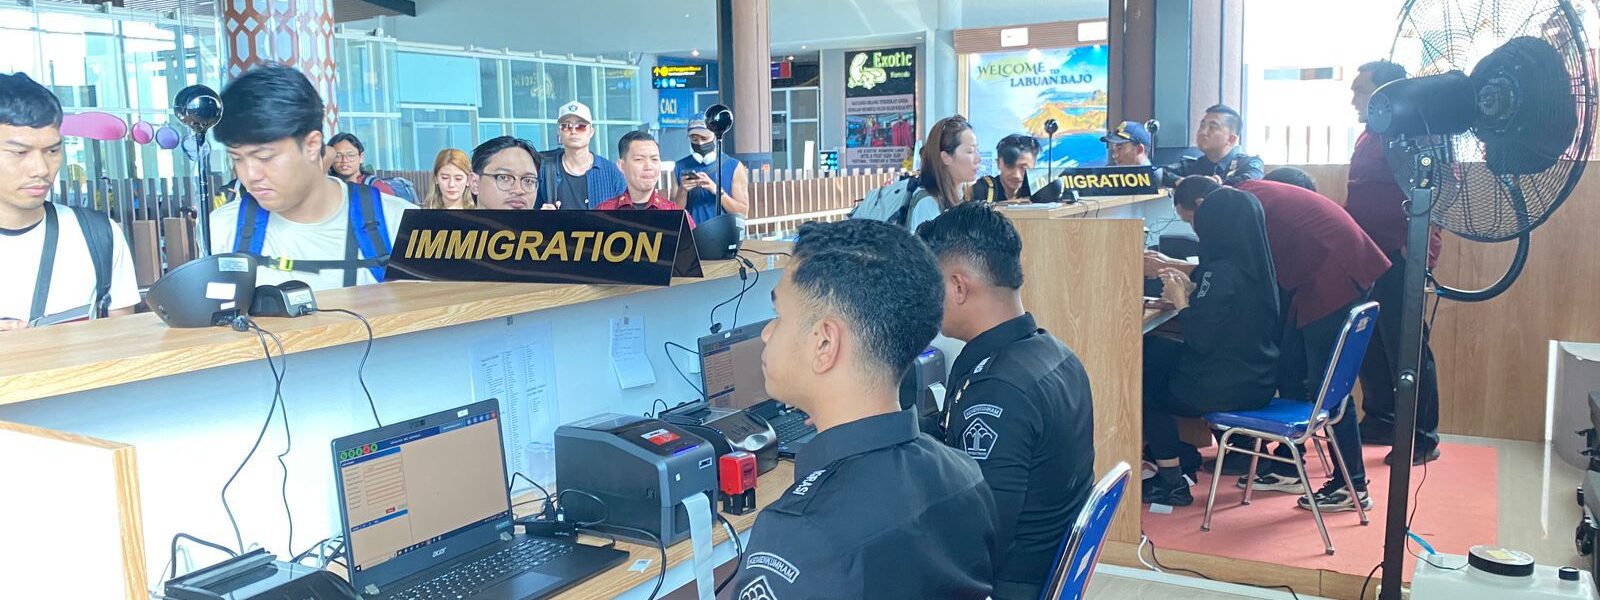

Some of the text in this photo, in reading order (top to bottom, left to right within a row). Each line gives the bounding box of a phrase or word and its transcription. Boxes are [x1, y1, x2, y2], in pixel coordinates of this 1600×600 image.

[873, 51, 912, 67] Exotic
[977, 62, 1046, 77] WELCOME
[1010, 74, 1093, 87] LABUAN BAJO
[660, 98, 677, 114] CACI
[404, 229, 663, 263] IMMIGRATION
[432, 546, 448, 558] acer
